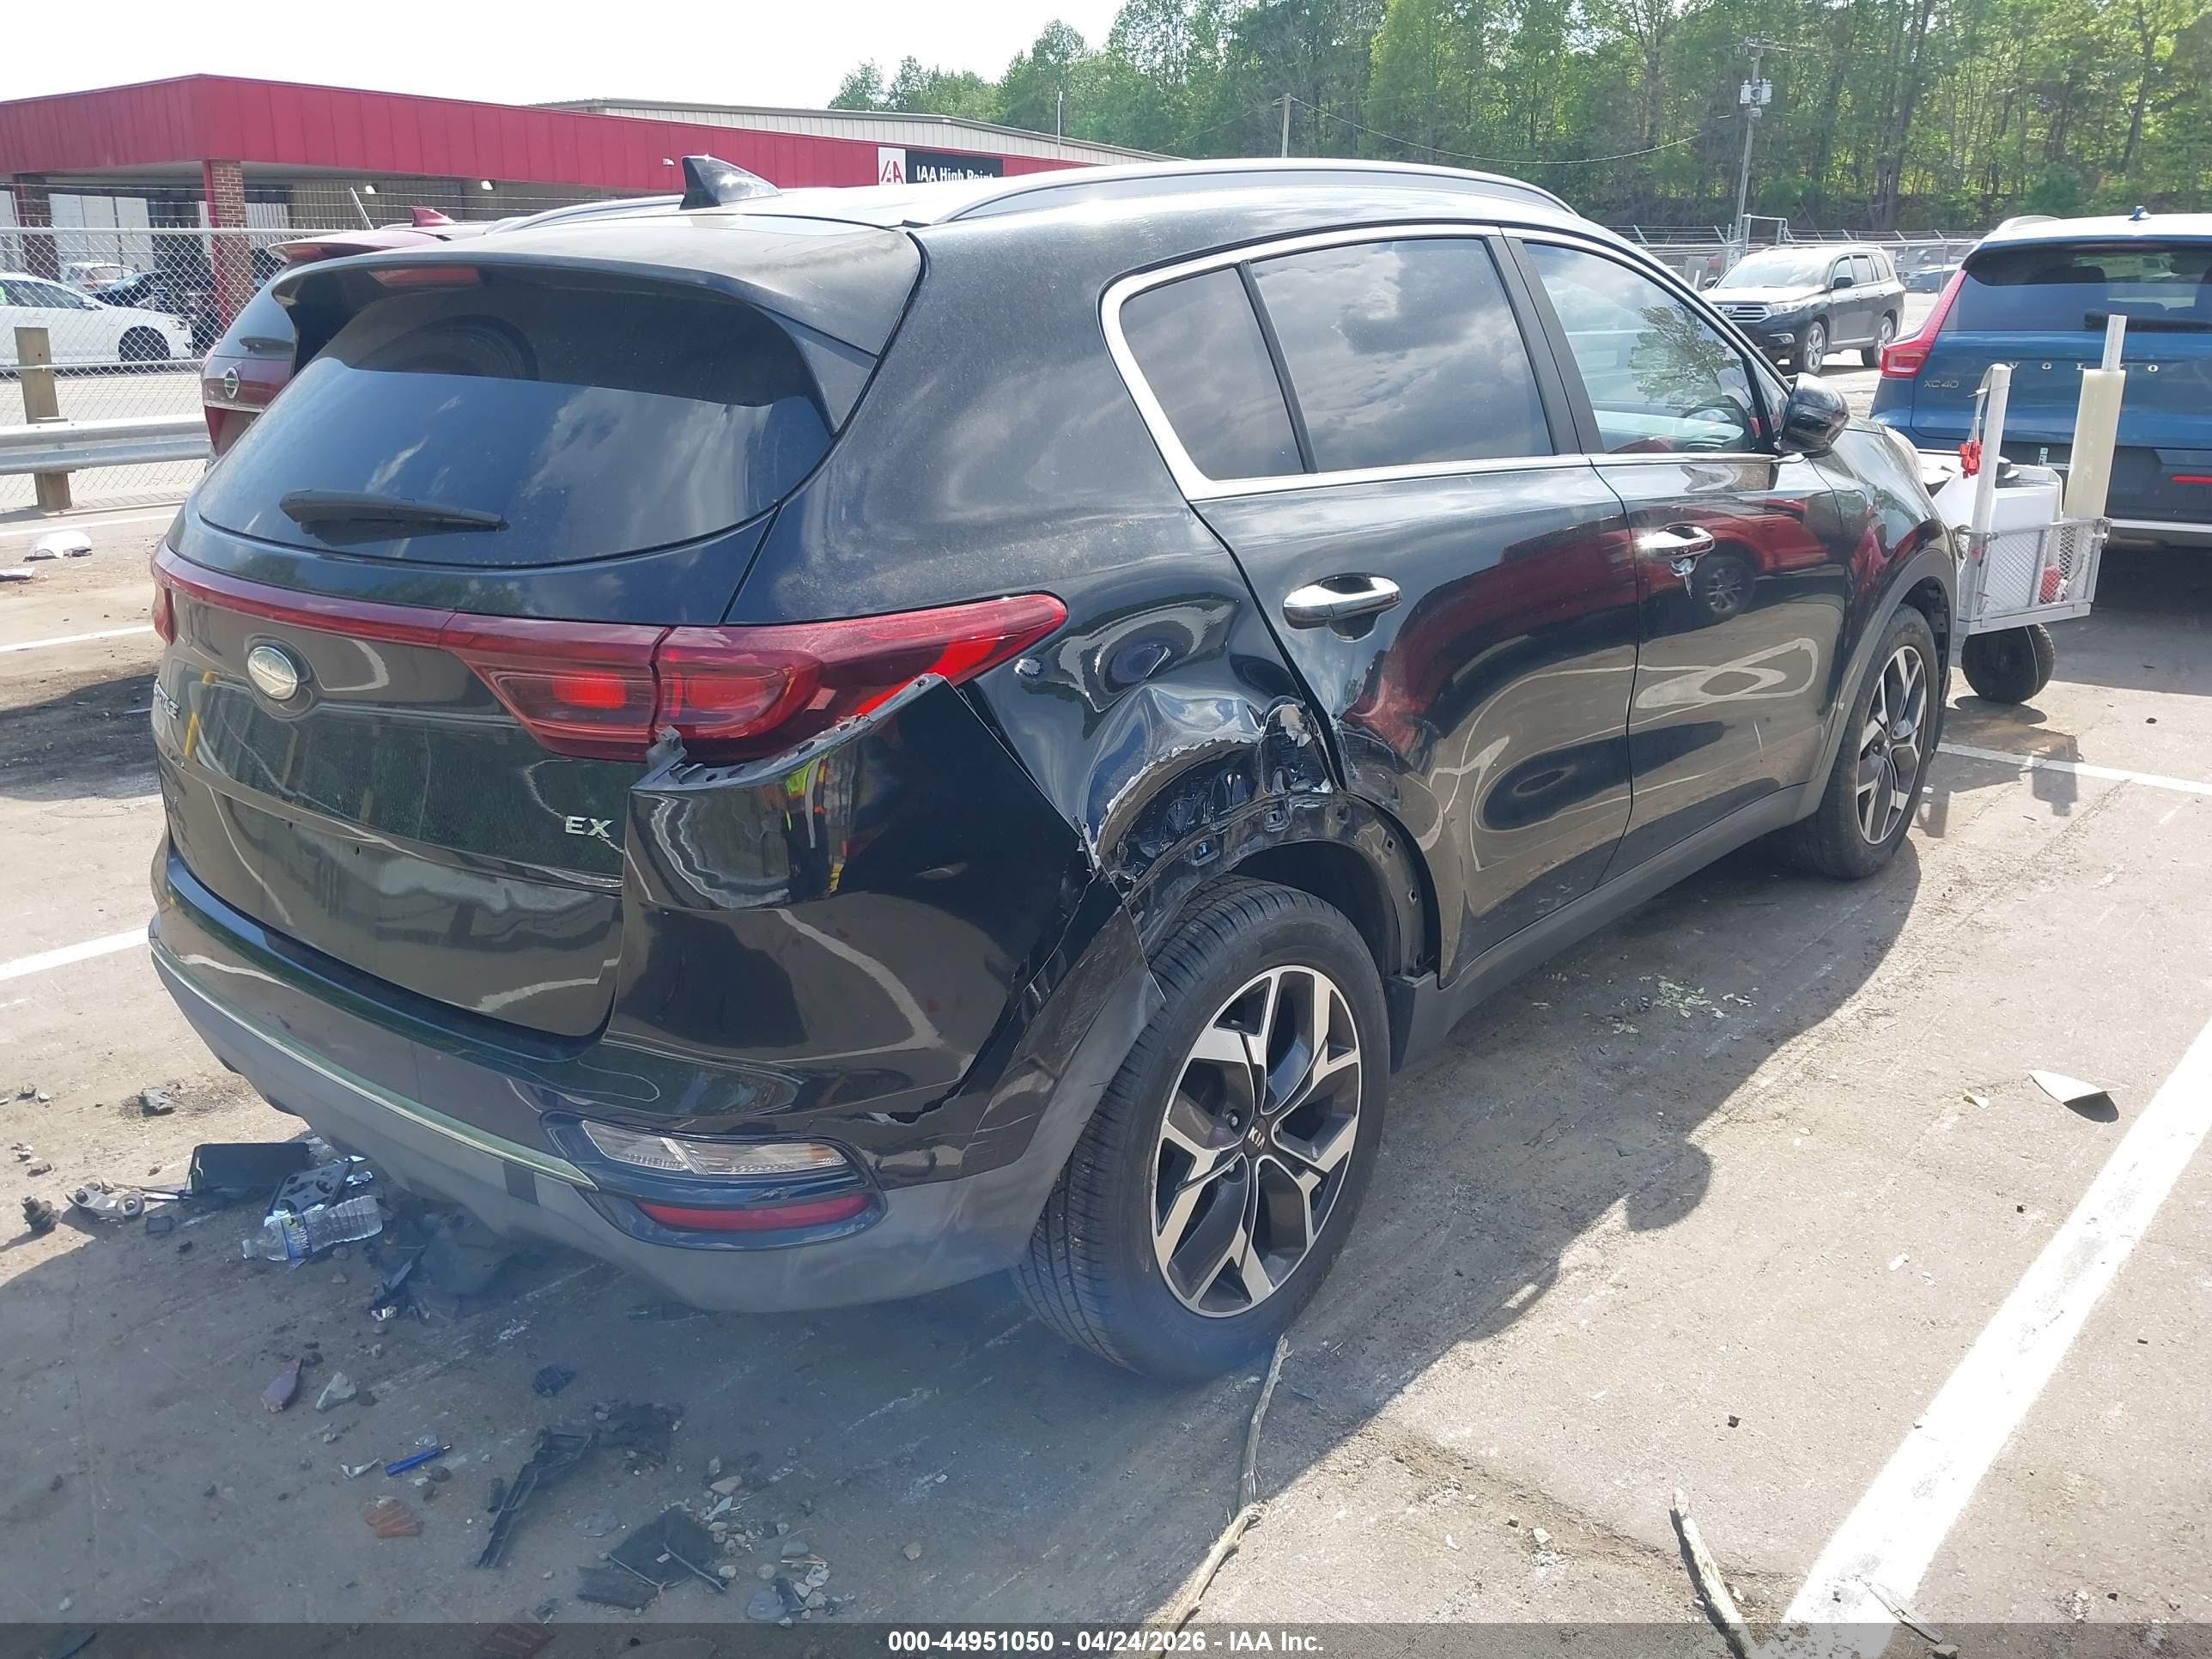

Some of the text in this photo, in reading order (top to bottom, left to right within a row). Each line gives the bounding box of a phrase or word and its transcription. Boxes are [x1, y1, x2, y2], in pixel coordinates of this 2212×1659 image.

[916, 165, 938, 182] IAA
[2007, 362, 2160, 373] VOLO
[1923, 380, 1960, 389] XC40
[565, 815, 615, 838] EX
[1248, 1126, 1266, 1151] KIA
[297, 1225, 310, 1249] PARK
